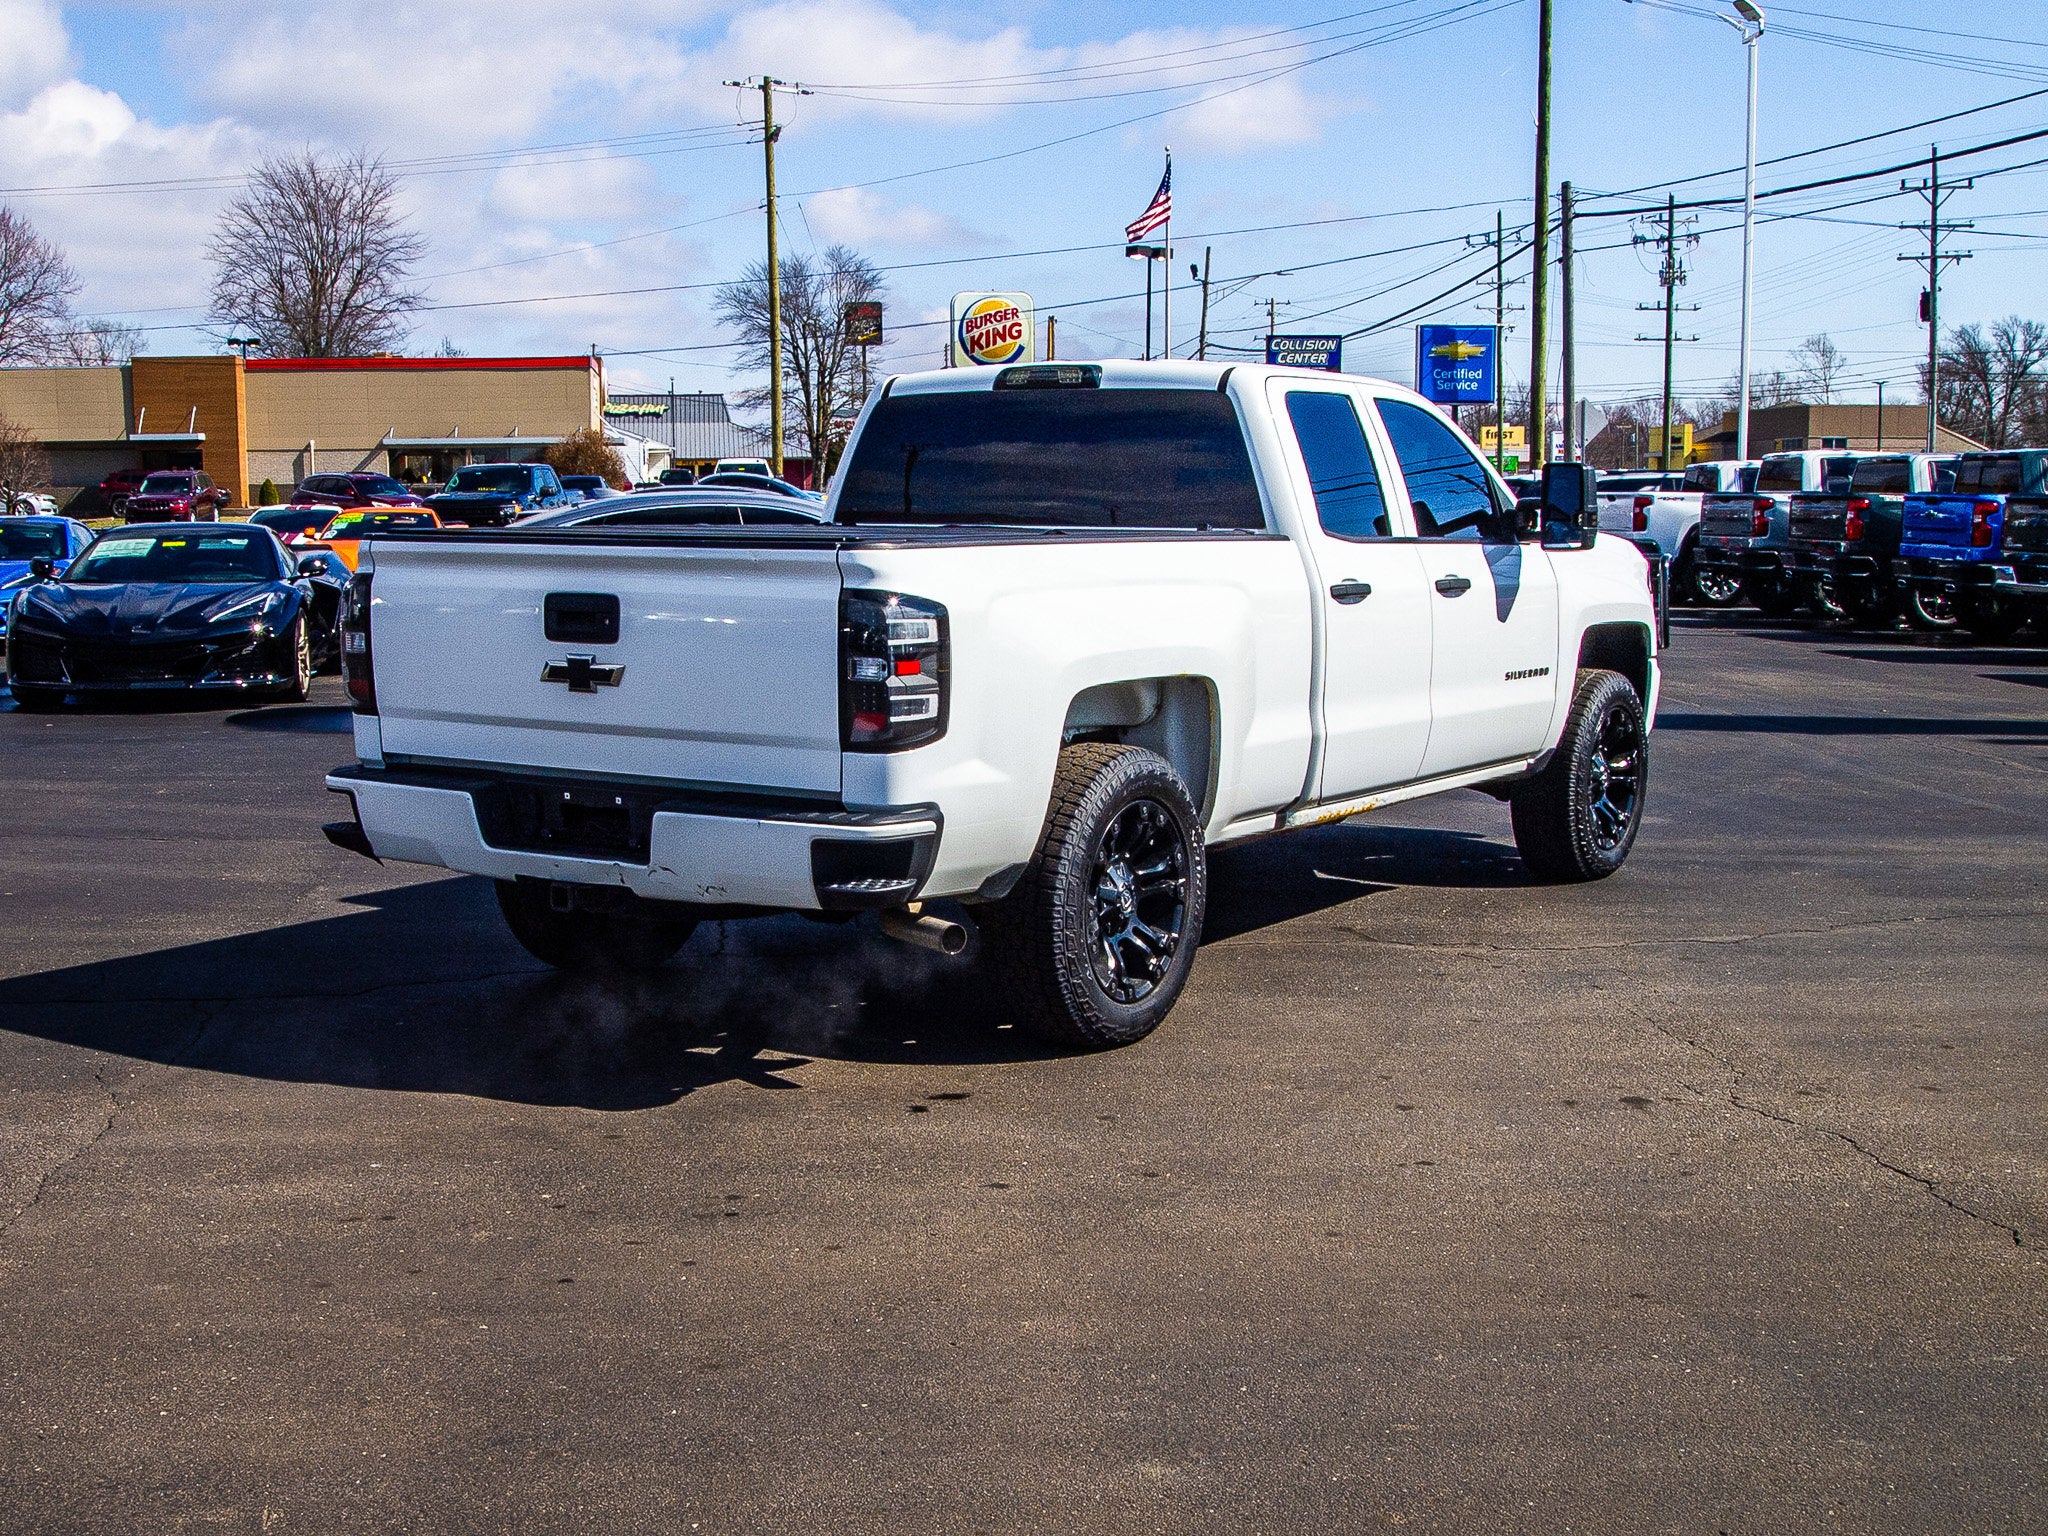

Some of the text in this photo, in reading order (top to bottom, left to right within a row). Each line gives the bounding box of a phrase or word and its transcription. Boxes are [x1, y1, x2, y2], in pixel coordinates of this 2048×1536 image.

[965, 307, 1019, 335] BURGER
[969, 321, 1023, 355] KING
[1271, 338, 1337, 350] COLLISION
[1277, 352, 1328, 364] CENTER
[1433, 368, 1482, 379] Certified
[1437, 380, 1478, 390] Service
[639, 403, 670, 415] Hut
[1504, 666, 1550, 681] SILVERADO
